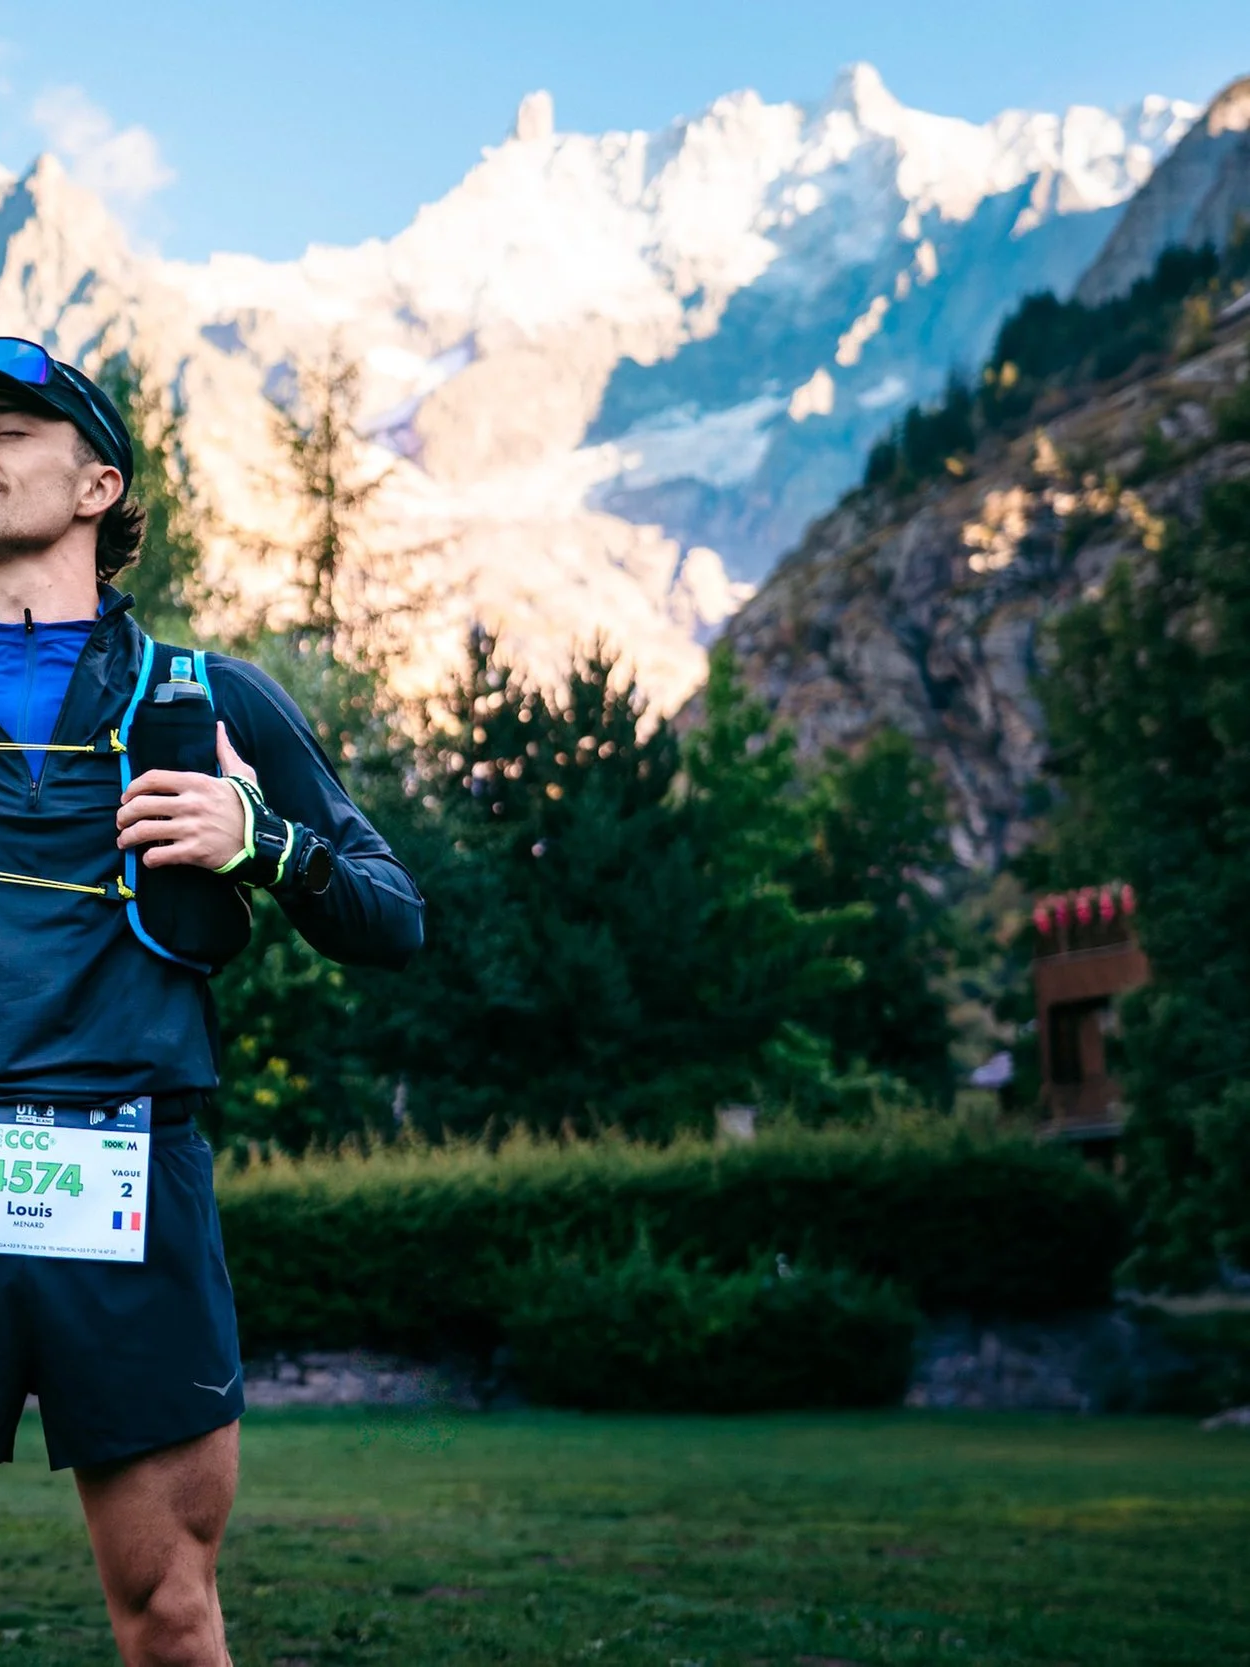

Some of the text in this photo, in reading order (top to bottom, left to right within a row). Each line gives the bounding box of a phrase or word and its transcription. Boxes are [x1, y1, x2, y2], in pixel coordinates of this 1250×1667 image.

[16, 1104, 54, 1116] UTB
[104, 1140, 124, 1149] 100K
[111, 1169, 141, 1177] VAGUE
[120, 1182, 133, 1198] 2
[7, 1200, 53, 1218] Louis
[12, 1220, 45, 1229] MENARD
